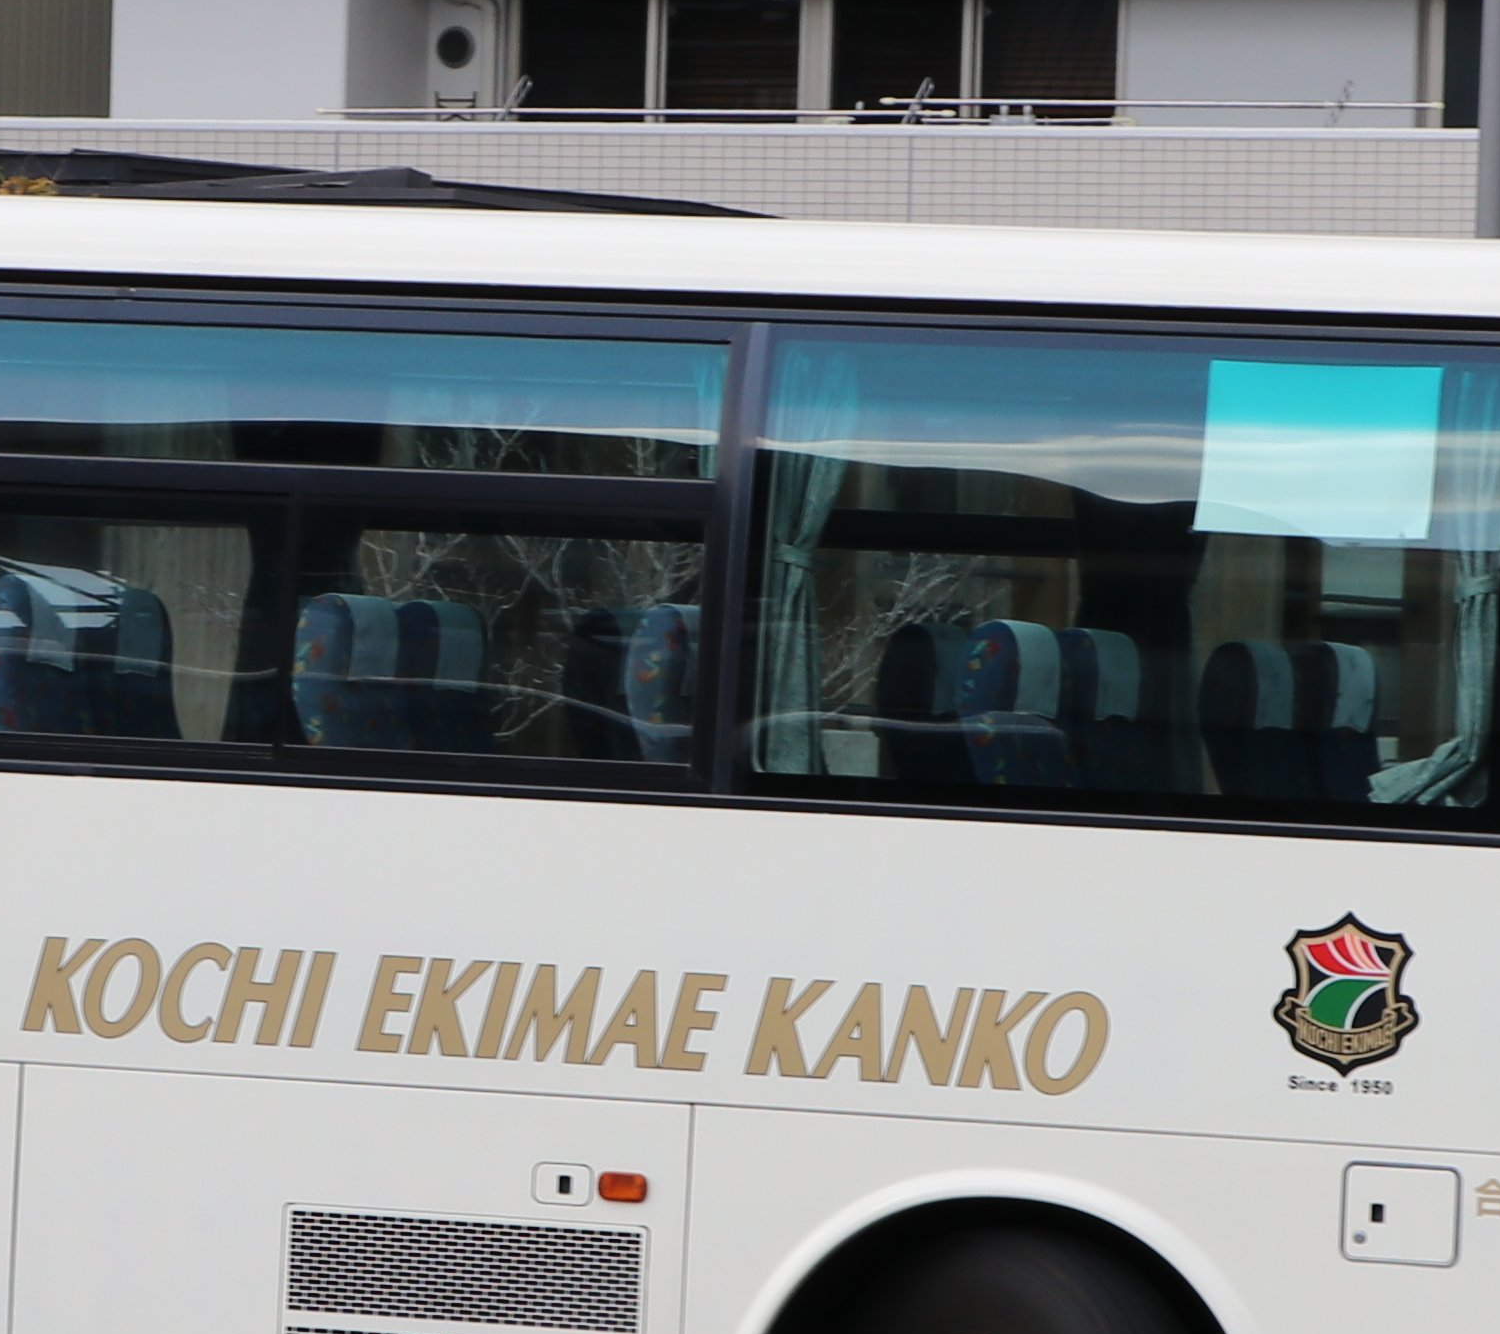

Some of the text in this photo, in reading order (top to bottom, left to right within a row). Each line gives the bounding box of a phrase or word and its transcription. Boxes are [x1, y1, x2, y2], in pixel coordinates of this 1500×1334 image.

[22, 936, 1111, 1097] KOCHI EKIMAE KANKO
[1288, 1075, 1393, 1095] Since 1950
